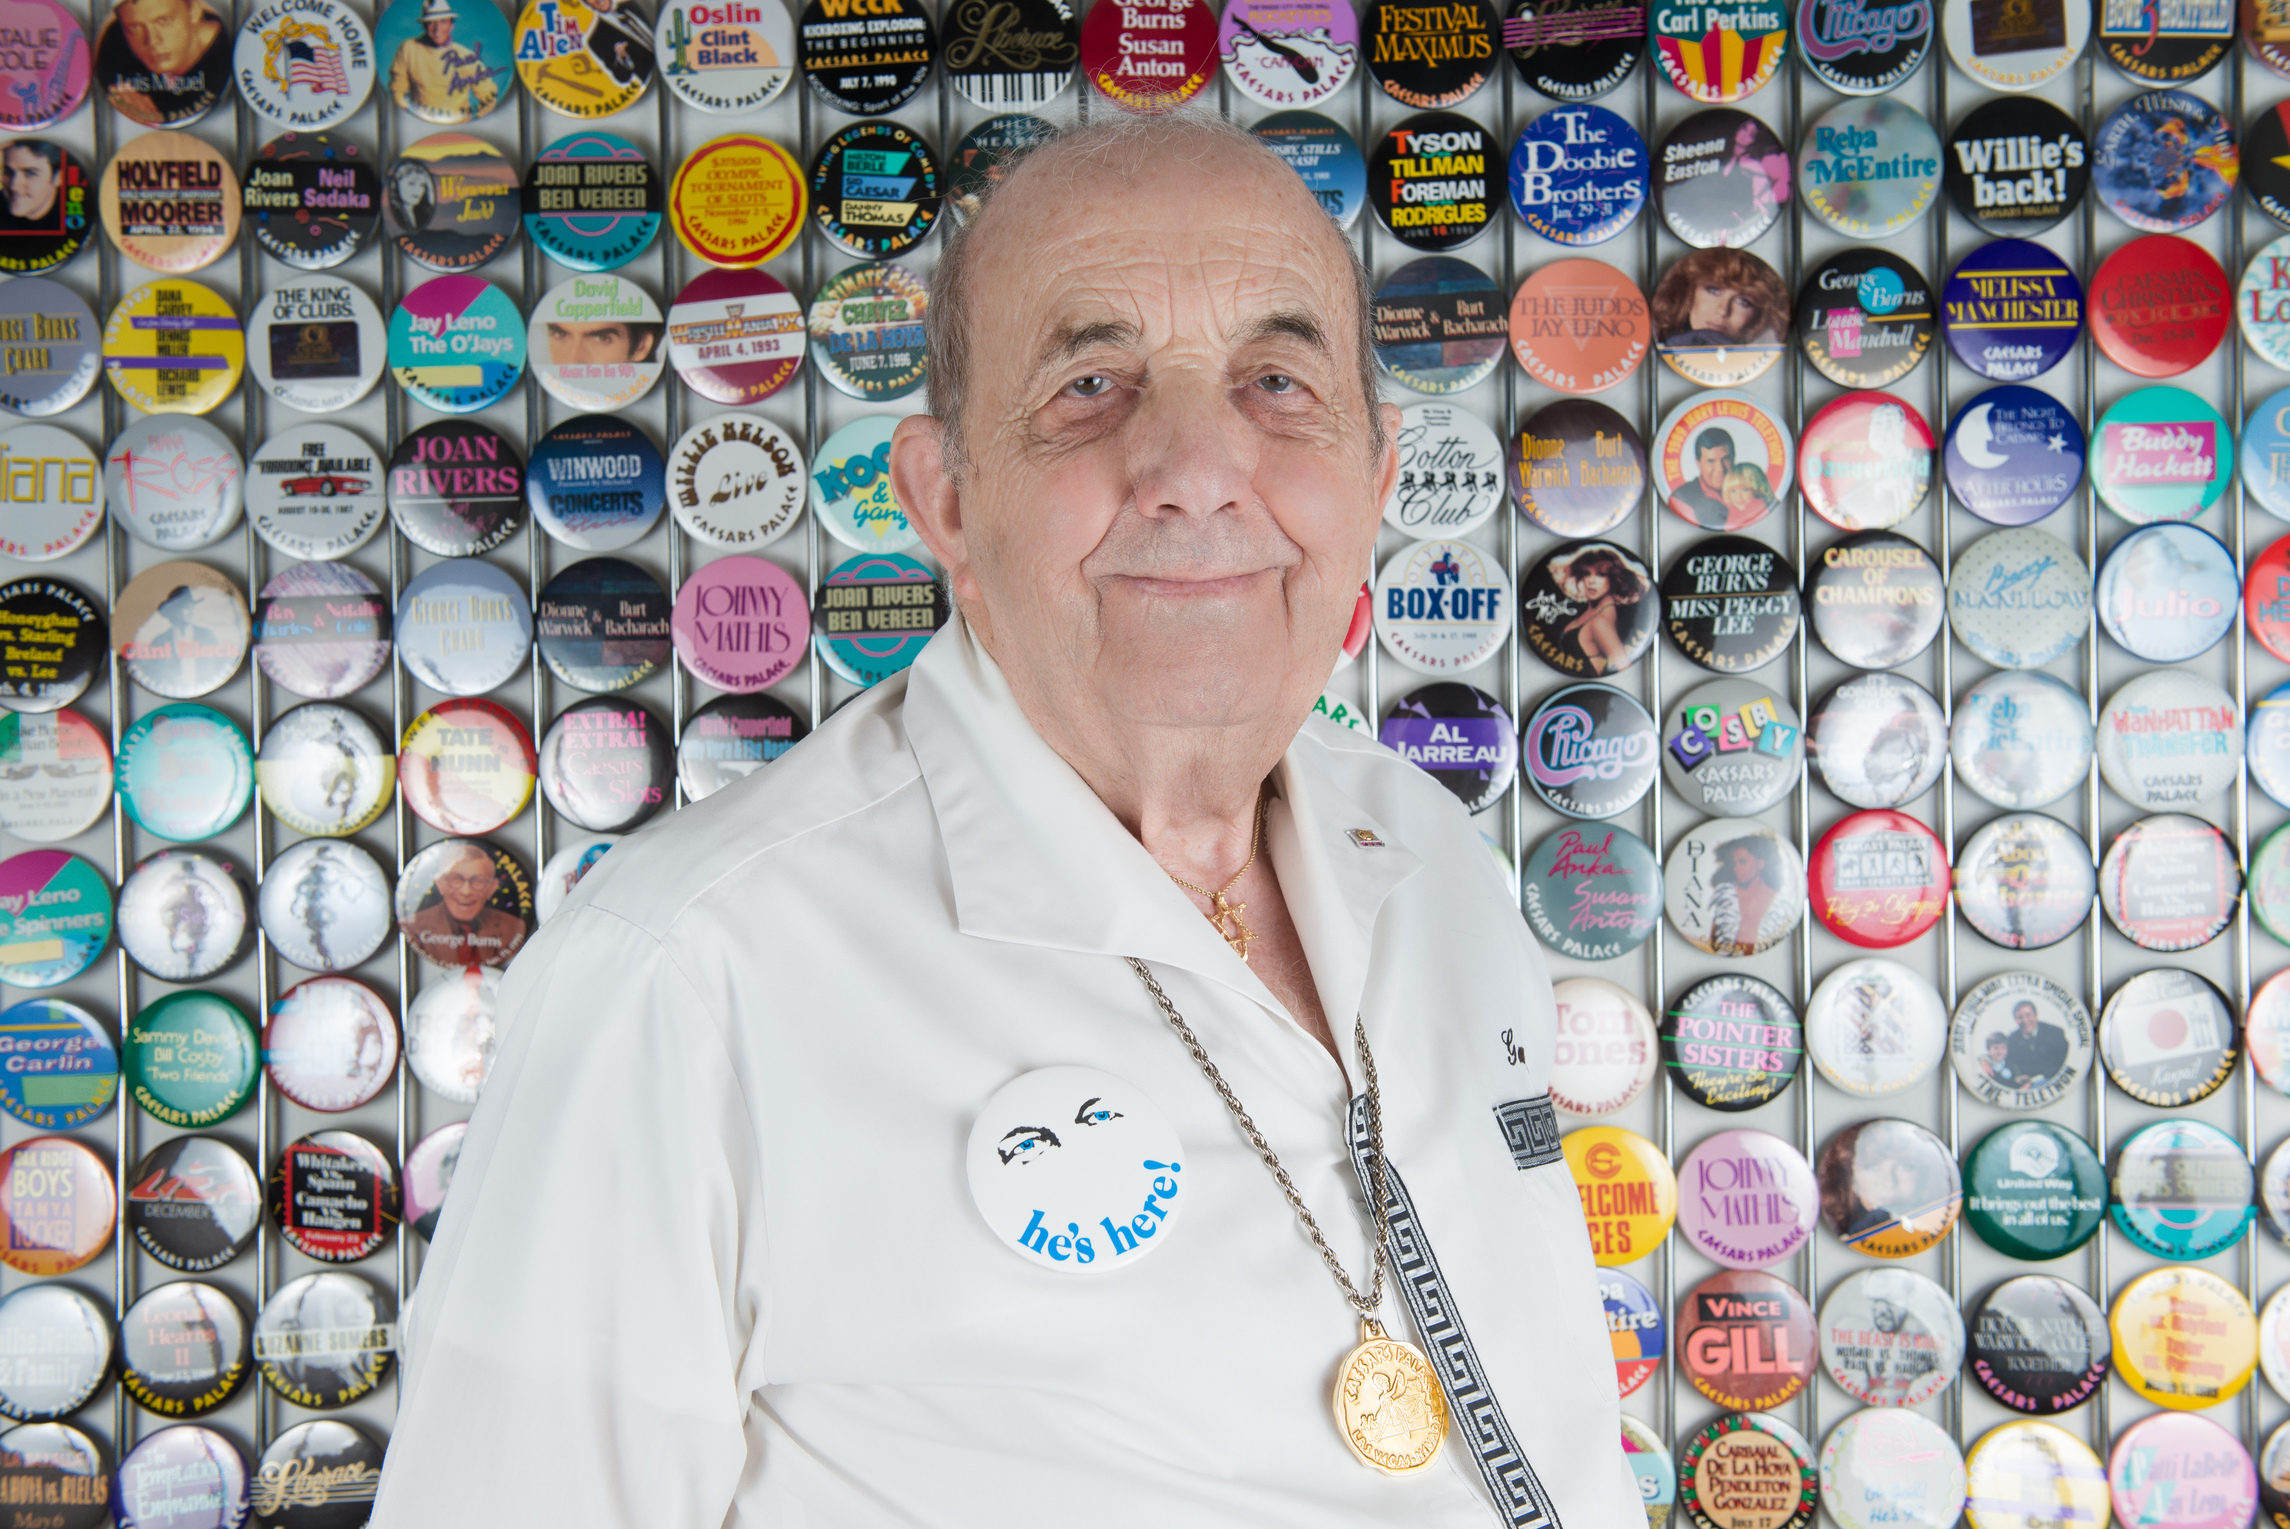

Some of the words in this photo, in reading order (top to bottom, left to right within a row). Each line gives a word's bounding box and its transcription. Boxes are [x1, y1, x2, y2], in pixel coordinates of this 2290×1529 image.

[690, 3, 761, 27] Oslin
[1122, 8, 1186, 30] Burns
[1379, 2, 1487, 34] FESTIVAL
[1657, 8, 1699, 33] Carl
[1705, 7, 1780, 32] Perkins
[246, 0, 336, 35] WELCOME
[336, 14, 369, 70] HOME
[700, 31, 750, 47] Clint
[803, 20, 866, 39] KICKBOXING
[867, 17, 927, 35] EXPLOSION:
[806, 40, 836, 51] THE
[840, 35, 925, 49] BEGINNING
[1119, 33, 1185, 56] Susan
[1372, 34, 1492, 68] MAXIMUS
[697, 48, 759, 65] Black
[805, 54, 869, 70] CAESARS
[873, 50, 929, 64] PALACE
[1116, 56, 1186, 77] Anton
[116, 73, 156, 92] Luis
[159, 71, 205, 95] Miguel
[1234, 61, 1294, 103] CAESARS
[1303, 57, 1352, 101] PALACE
[239, 67, 282, 118] CAESARS
[288, 100, 344, 124] PALACE
[535, 86, 592, 115] CAESARS
[596, 79, 640, 115] PALACE
[1552, 111, 1606, 145] The
[1815, 126, 1878, 153] Reba
[1389, 130, 1482, 154] TYSON
[1662, 137, 1726, 164] Sheena
[845, 160, 887, 174] BERLE
[1389, 155, 1484, 178] TILLMAN
[1523, 140, 1638, 174] Doobie
[1954, 135, 2084, 175] Willie's
[117, 160, 222, 189] HOLYFIELD
[250, 168, 293, 187] Joan
[318, 168, 355, 188] Neil
[533, 165, 581, 186] JOAN
[586, 164, 648, 185] RIVERS
[706, 168, 765, 181] OLYMPIC
[1664, 159, 1720, 183] Easton
[1806, 154, 1937, 184] McEntire
[244, 189, 300, 207] Rivers
[304, 188, 370, 208] Sedaka
[690, 179, 784, 193] TOURNAMENT
[706, 192, 724, 203] OF
[727, 191, 767, 204] SLOTS
[844, 184, 900, 198] CAESAR
[1390, 179, 1486, 203] FOREMAN
[1520, 171, 1642, 207] Brothers
[1973, 173, 2067, 208] back!
[539, 189, 575, 209] BEN
[580, 188, 647, 208] VEREEN
[120, 201, 224, 224] MOORER
[844, 211, 906, 224] THOMAS
[1391, 204, 1487, 227] RODRIGUES
[274, 288, 307, 304] THE
[311, 286, 350, 302] KING
[1970, 277, 2056, 299] MELISSA
[273, 302, 294, 320] OF
[839, 302, 908, 325] CHAVEZ
[1517, 299, 1563, 317] THE
[1567, 297, 1645, 317] JUDDS
[1945, 299, 2079, 322] MANCHESTER
[408, 314, 441, 340] Jay
[445, 314, 496, 334] Leno
[1530, 320, 1569, 339] JAY
[1572, 321, 1636, 338] LENO
[408, 335, 447, 357] The
[450, 333, 514, 358] O'Jays
[699, 344, 735, 360] APRIL
[738, 343, 749, 358] 4,
[751, 338, 780, 354] 1993
[829, 334, 851, 354] DE
[854, 332, 876, 352] LA
[881, 327, 926, 349] HOYA
[411, 436, 499, 463] JOAN
[2120, 426, 2204, 454] Buddy
[546, 455, 642, 481] WINWOOD
[676, 427, 719, 509] WILLIE
[718, 420, 797, 478] NELSON
[2110, 452, 2215, 481] Hackett
[394, 466, 520, 497] RIVERS
[709, 470, 770, 508] Live
[549, 491, 643, 516] CONCERTS
[1686, 552, 1776, 576] GEORGE
[1823, 548, 1928, 568] CAROUSEL
[1694, 572, 1769, 594] BURNS
[1862, 566, 1890, 587] OF
[693, 584, 785, 619] JOHNNY
[1667, 596, 1718, 619] MISS
[1722, 594, 1795, 617] PEGGY
[1815, 584, 1935, 606] CHAMPIONS
[2115, 588, 2222, 622] Julio
[540, 601, 587, 620] Dionne
[619, 600, 647, 618] Burt
[537, 618, 593, 638] Warwick
[605, 617, 670, 637] Bacharach
[695, 621, 791, 655] MATHIS
[1712, 615, 1755, 637] LEE
[693, 656, 741, 689] CAESARS
[743, 659, 791, 688] PALACE
[563, 712, 647, 731] EXTRA!
[1428, 721, 1470, 744] AL
[564, 730, 647, 750] EXTRA!
[1397, 740, 1508, 764] JARREAU
[1525, 704, 1659, 787] Chicago
[1556, 830, 1616, 859] Paul
[1548, 854, 1636, 879] Anka
[1574, 880, 1651, 906] Susan
[1681, 839, 1706, 929] DIANA
[1524, 880, 1563, 951] CAESARS
[1560, 939, 1622, 960] PALACE
[1568, 904, 1655, 931] Anton
[1719, 1000, 1756, 1020] THE
[1676, 1016, 1794, 1049] POINTER
[0, 1035, 99, 1055] George
[5, 1055, 93, 1073] Carlin
[1682, 1043, 1784, 1073] SISTERS
[12, 1169, 74, 1199] BOYS
[306, 1174, 357, 1194] Spann
[1017, 1209, 1095, 1264] he's
[1100, 1160, 1181, 1255] here!
[1700, 1192, 1800, 1228] MATHIS
[136, 1226, 184, 1271] CAESARS
[186, 1246, 236, 1271] PALACE
[1705, 1296, 1782, 1319] VINCE
[1685, 1326, 1804, 1376] GILL
[1352, 1430, 1372, 1454] LAS
[1706, 1459, 1730, 1476] DE
[1731, 1459, 1754, 1476] LA
[1756, 1459, 1793, 1476] HOYA
[1708, 1476, 1791, 1496] PENDLETON
[1711, 1495, 1788, 1512] GONZALEZ
